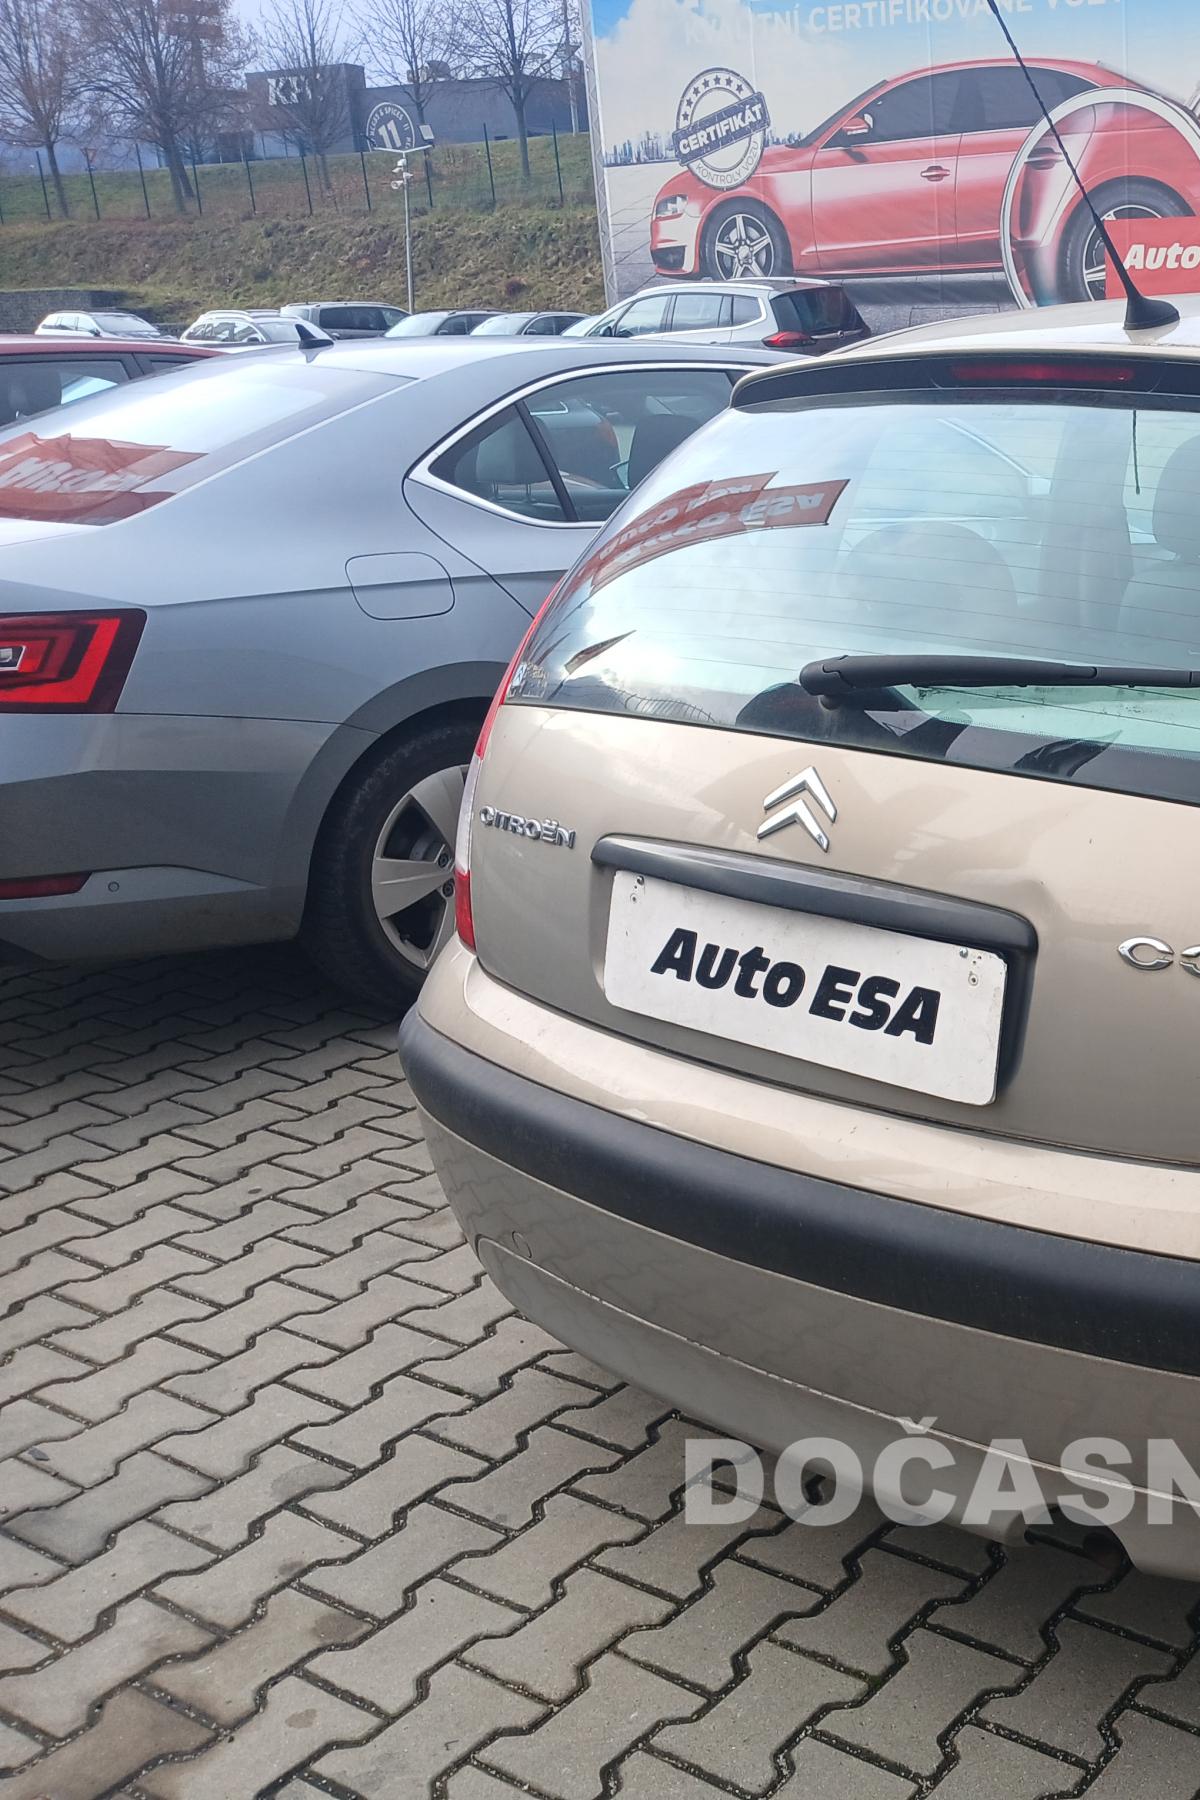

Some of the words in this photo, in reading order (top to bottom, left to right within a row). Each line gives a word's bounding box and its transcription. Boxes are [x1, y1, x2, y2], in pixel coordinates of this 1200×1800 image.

[679, 103, 762, 155] CERTIFIKÁT
[696, 162, 742, 184] KONTROLY
[480, 805, 576, 850] CITROËN
[650, 927, 806, 1008] Auto
[808, 964, 941, 1045] ESA
